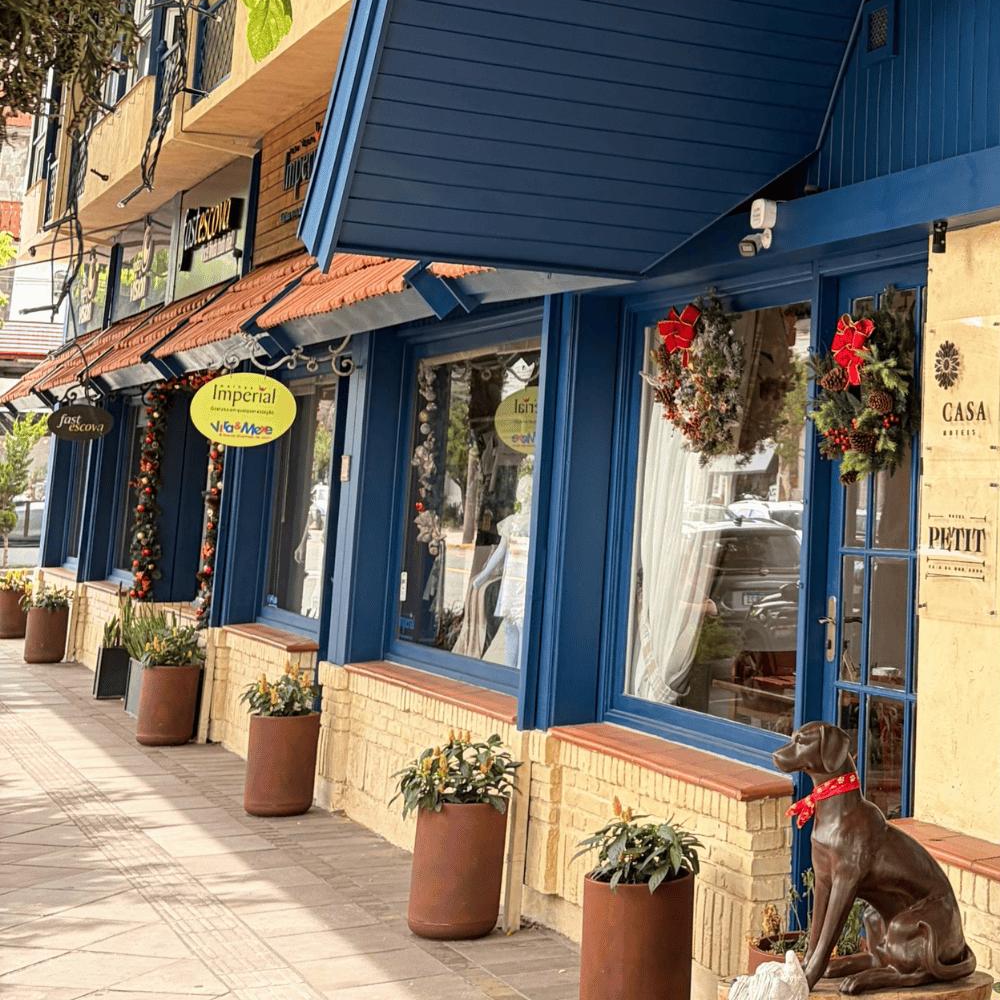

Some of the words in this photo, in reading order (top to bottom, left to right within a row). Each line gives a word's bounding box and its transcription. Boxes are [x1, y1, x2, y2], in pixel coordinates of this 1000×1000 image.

[212, 384, 276, 407] Imperial
[56, 413, 82, 428] fast
[942, 400, 987, 423] CASA
[68, 423, 104, 432] escova
[928, 526, 987, 553] PETIT
